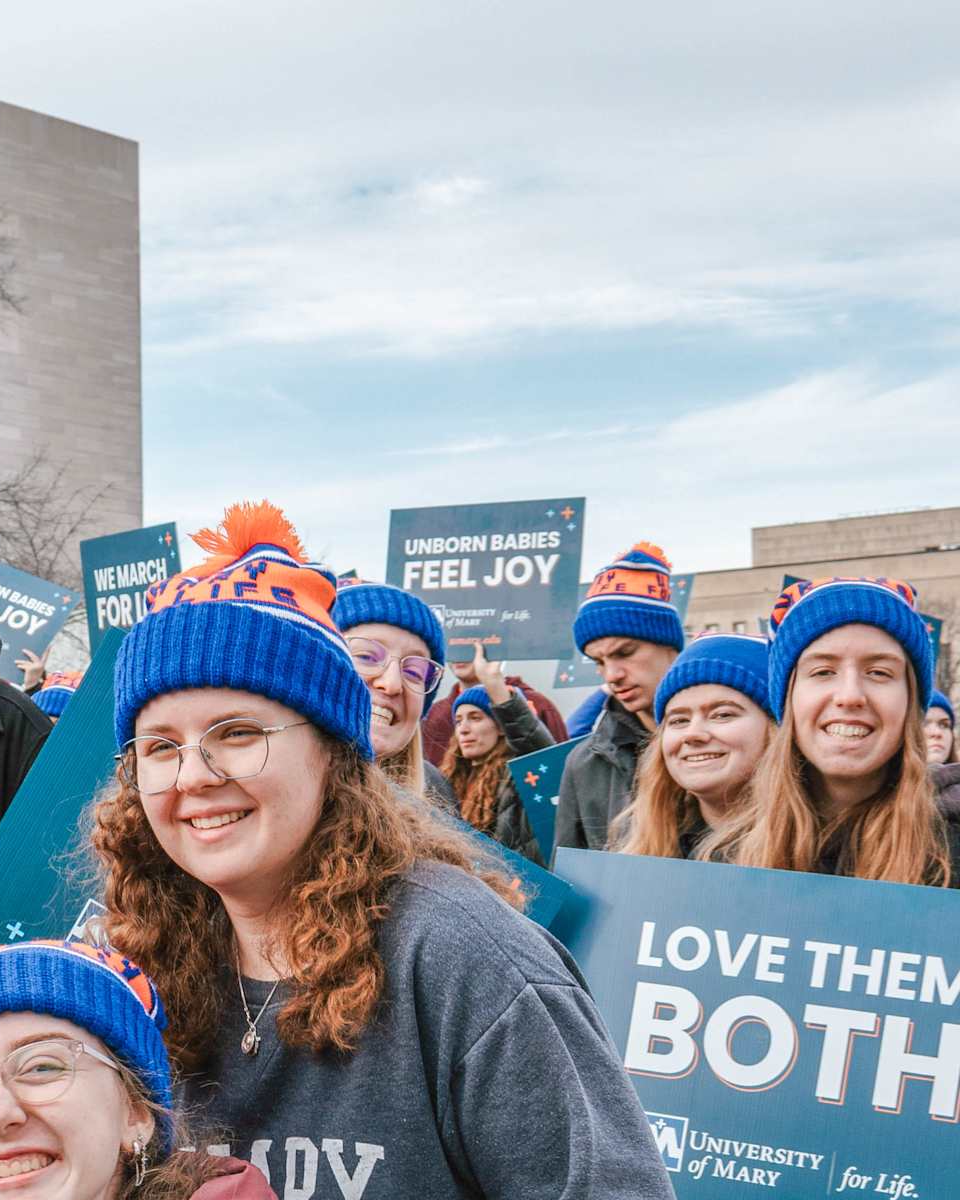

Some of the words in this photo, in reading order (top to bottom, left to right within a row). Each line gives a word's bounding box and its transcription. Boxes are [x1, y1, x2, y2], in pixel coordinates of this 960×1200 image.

[404, 534, 487, 555] UNBORN
[489, 531, 561, 551] BABIES
[94, 567, 116, 592] WE
[116, 557, 168, 589] MARCH
[403, 559, 477, 590] FEEL
[483, 554, 561, 586] JOY
[8, 589, 56, 617] BABIES
[96, 593, 133, 630] FOR
[637, 921, 790, 983] LOVE
[804, 940, 960, 1006] THEM
[624, 981, 960, 1123] BOTH
[688, 1156, 711, 1179] of
[712, 1158, 781, 1187] MARY
[689, 1130, 824, 1170] UNIVERSITY
[836, 1166, 872, 1192] for
[874, 1172, 920, 1200] Life.
